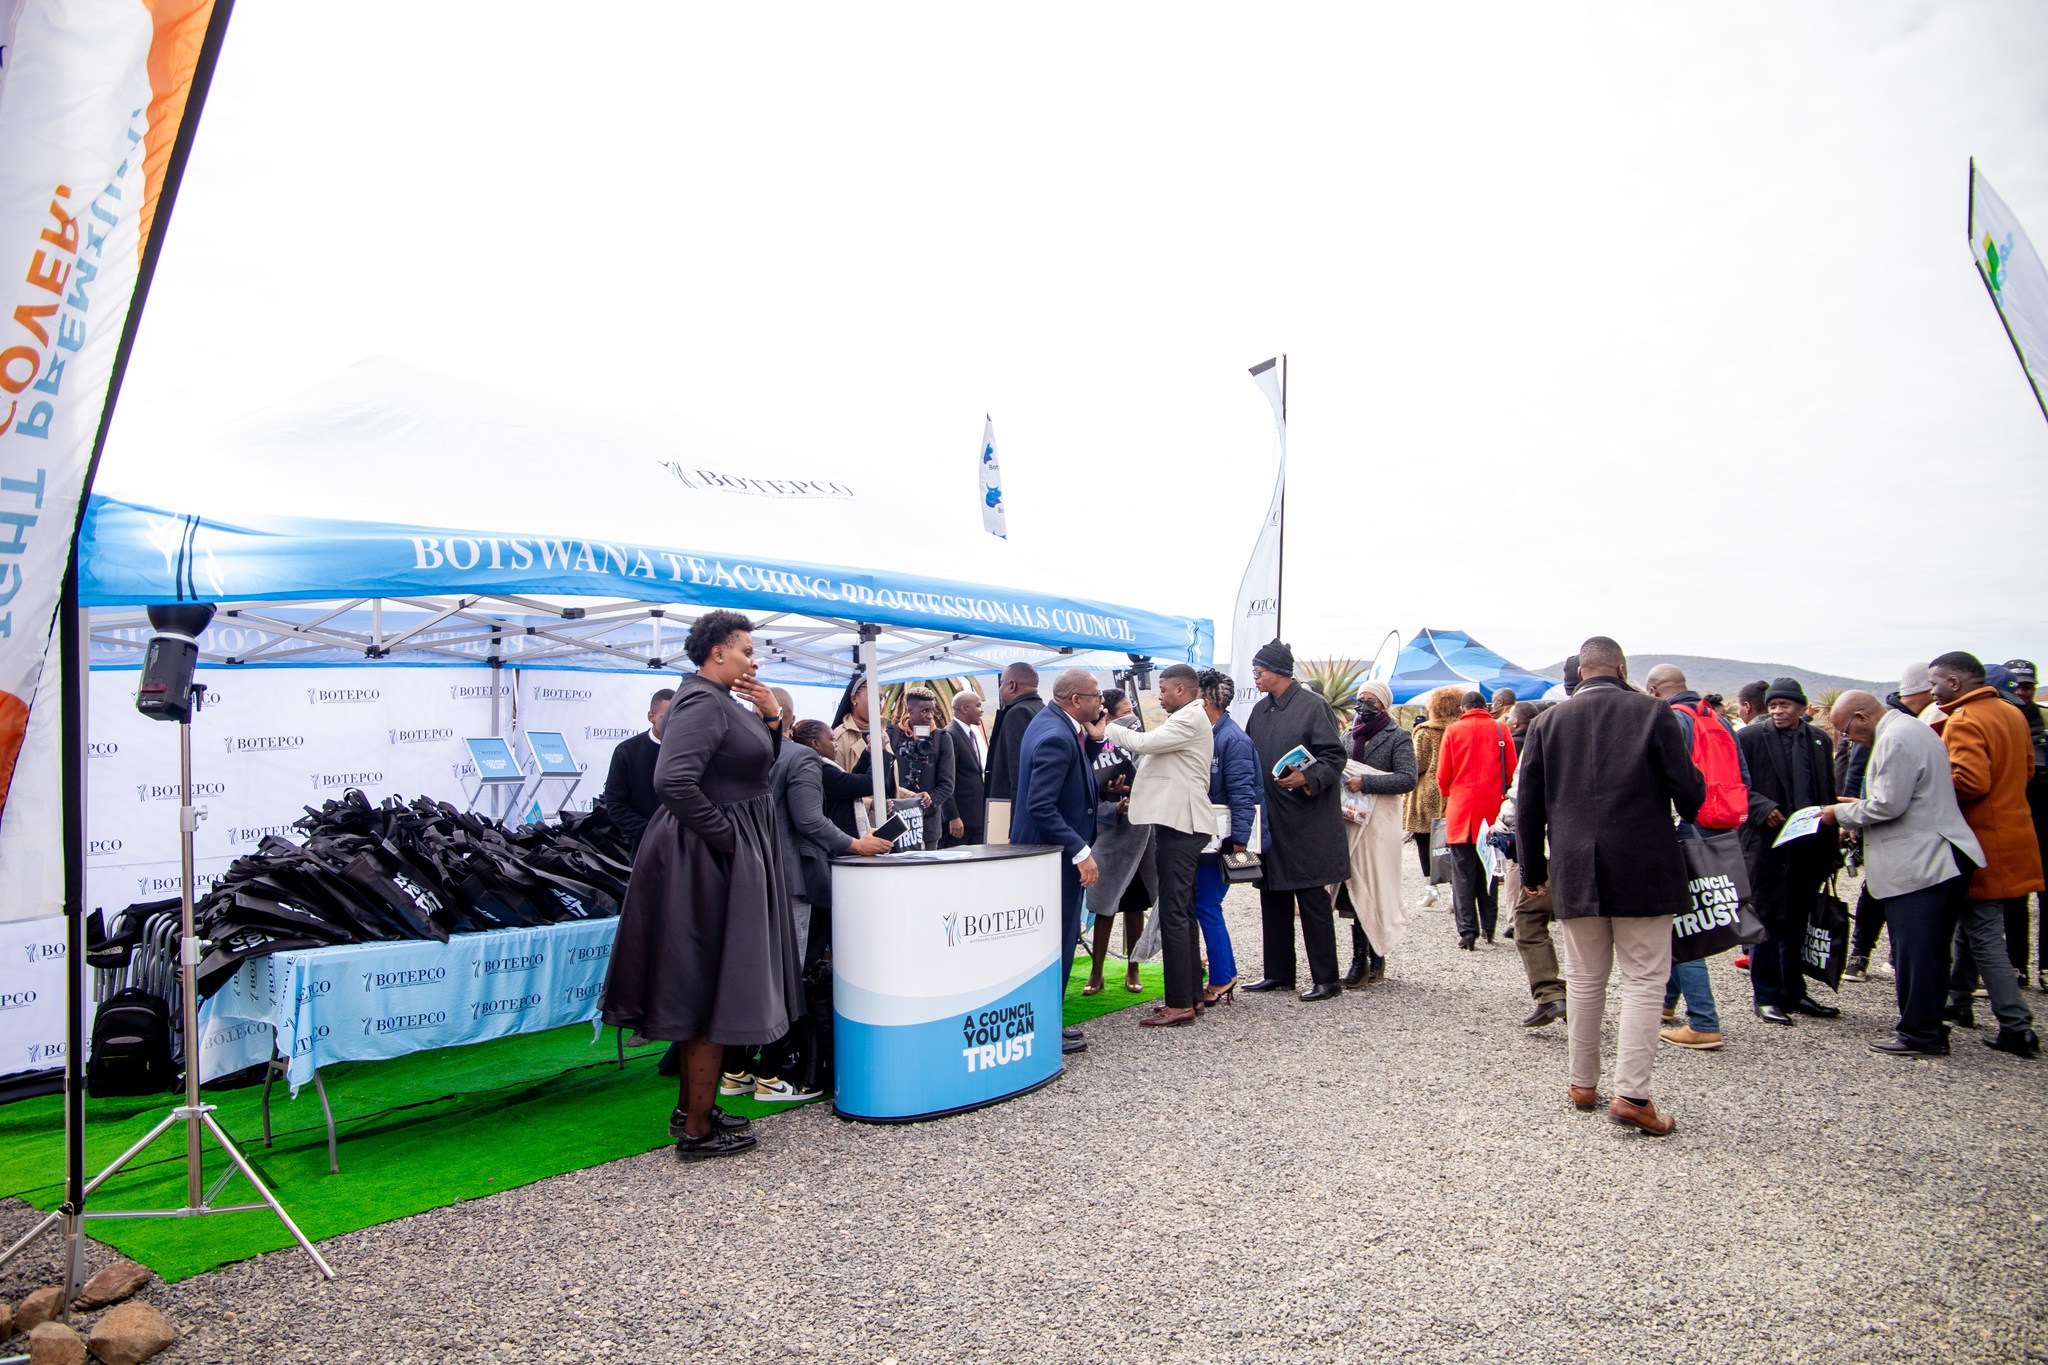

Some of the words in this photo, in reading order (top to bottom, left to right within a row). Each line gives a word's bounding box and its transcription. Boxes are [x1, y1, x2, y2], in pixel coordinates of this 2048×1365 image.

[697, 470, 853, 497] BOTEPCO
[411, 537, 656, 579] BOTSWANA
[660, 552, 840, 601] TEACHING
[1052, 608, 1136, 642] COUNCIL
[319, 689, 380, 701] BOTEPCO
[542, 688, 592, 699] BOTEPCO
[237, 735, 304, 749] BOTEPCO
[399, 728, 453, 741] BOTEPCO
[323, 772, 383, 786] BOTEPCO
[152, 873, 225, 890] BOTPCO
[1688, 874, 1735, 893] UNCIL
[1701, 887, 1739, 906] CAN
[963, 904, 1044, 937] BOTEPCO
[1673, 902, 1741, 938] TRUST
[578, 943, 614, 960] BOTE
[485, 953, 544, 973] BOTEPCO
[376, 966, 446, 987] BOTEPCO
[481, 994, 541, 1015] BOTEPCO
[376, 1010, 446, 1031] BOTEPCO
[963, 1015, 976, 1031] A
[979, 1001, 1034, 1028] COUNCIL
[963, 1024, 1000, 1048] YOU
[1005, 1015, 1035, 1039] CAN
[962, 1032, 1035, 1073] TRUST
